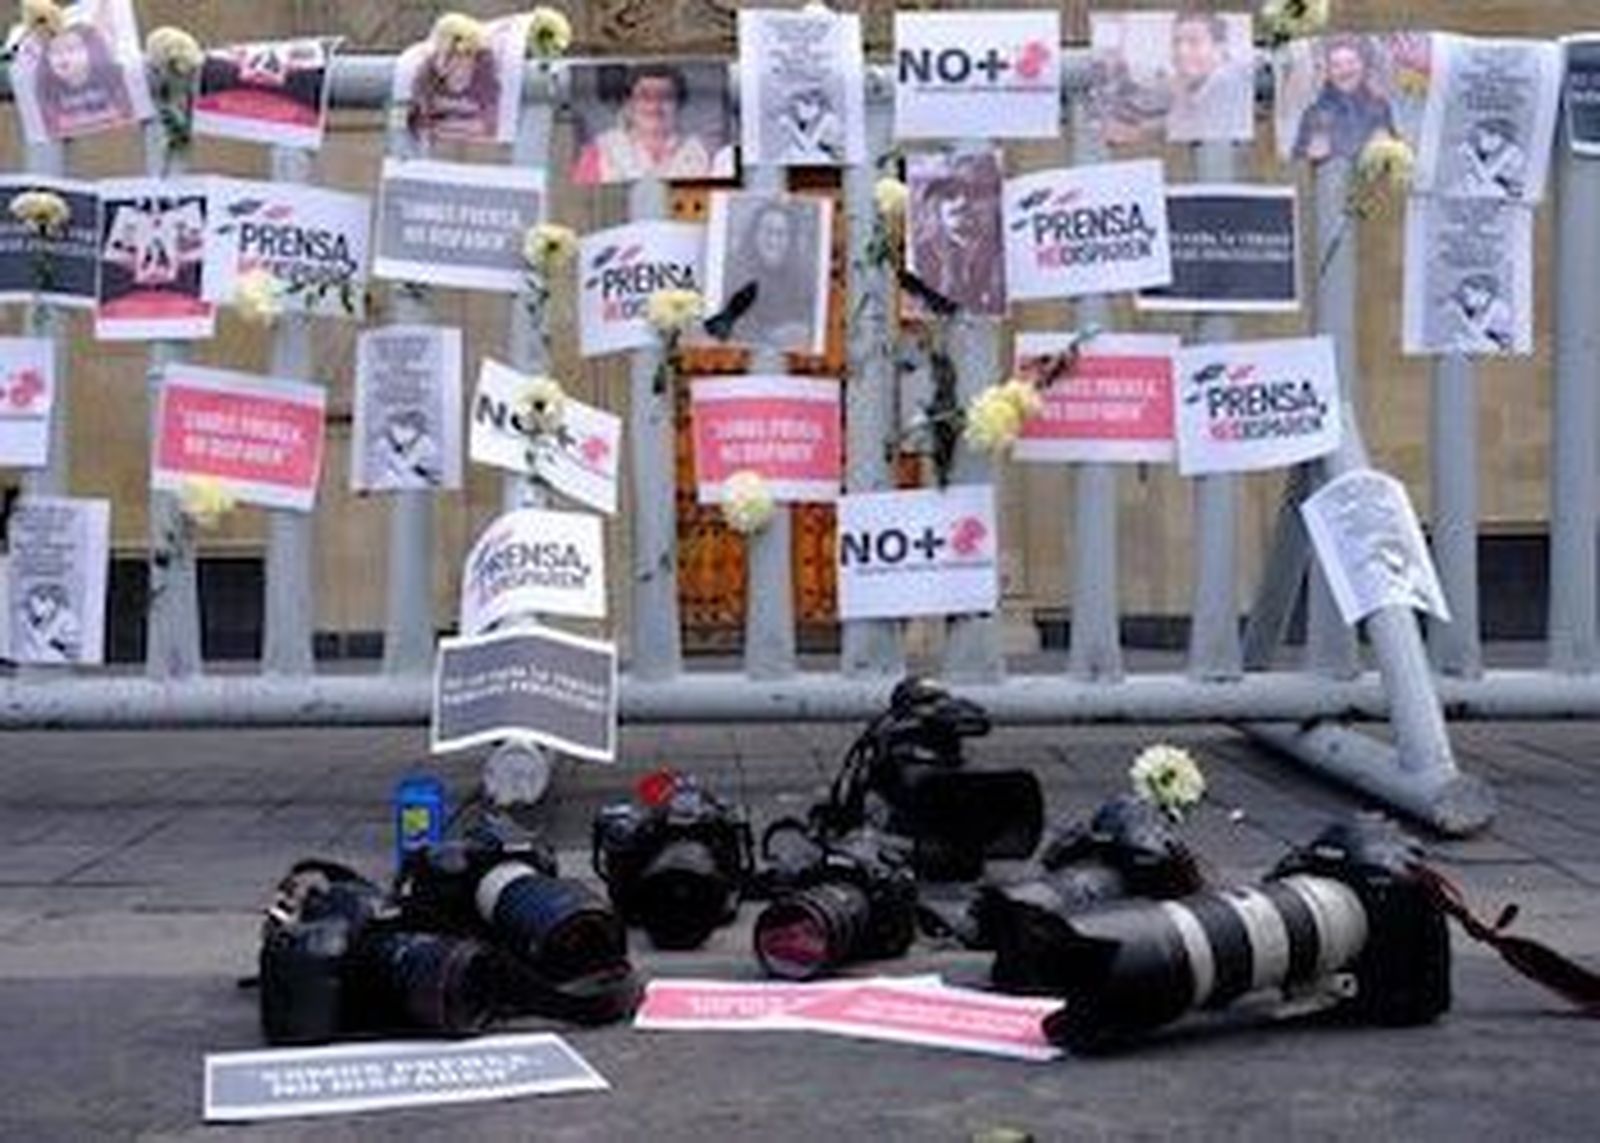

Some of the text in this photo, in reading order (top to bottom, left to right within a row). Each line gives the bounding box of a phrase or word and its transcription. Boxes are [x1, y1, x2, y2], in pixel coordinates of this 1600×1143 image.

[898, 47, 1010, 84] NO+
[1032, 202, 1157, 245] PRENSA,
[239, 222, 358, 272] PRENSA,
[1207, 381, 1328, 418] PRENSA,
[840, 527, 946, 567] NO+
